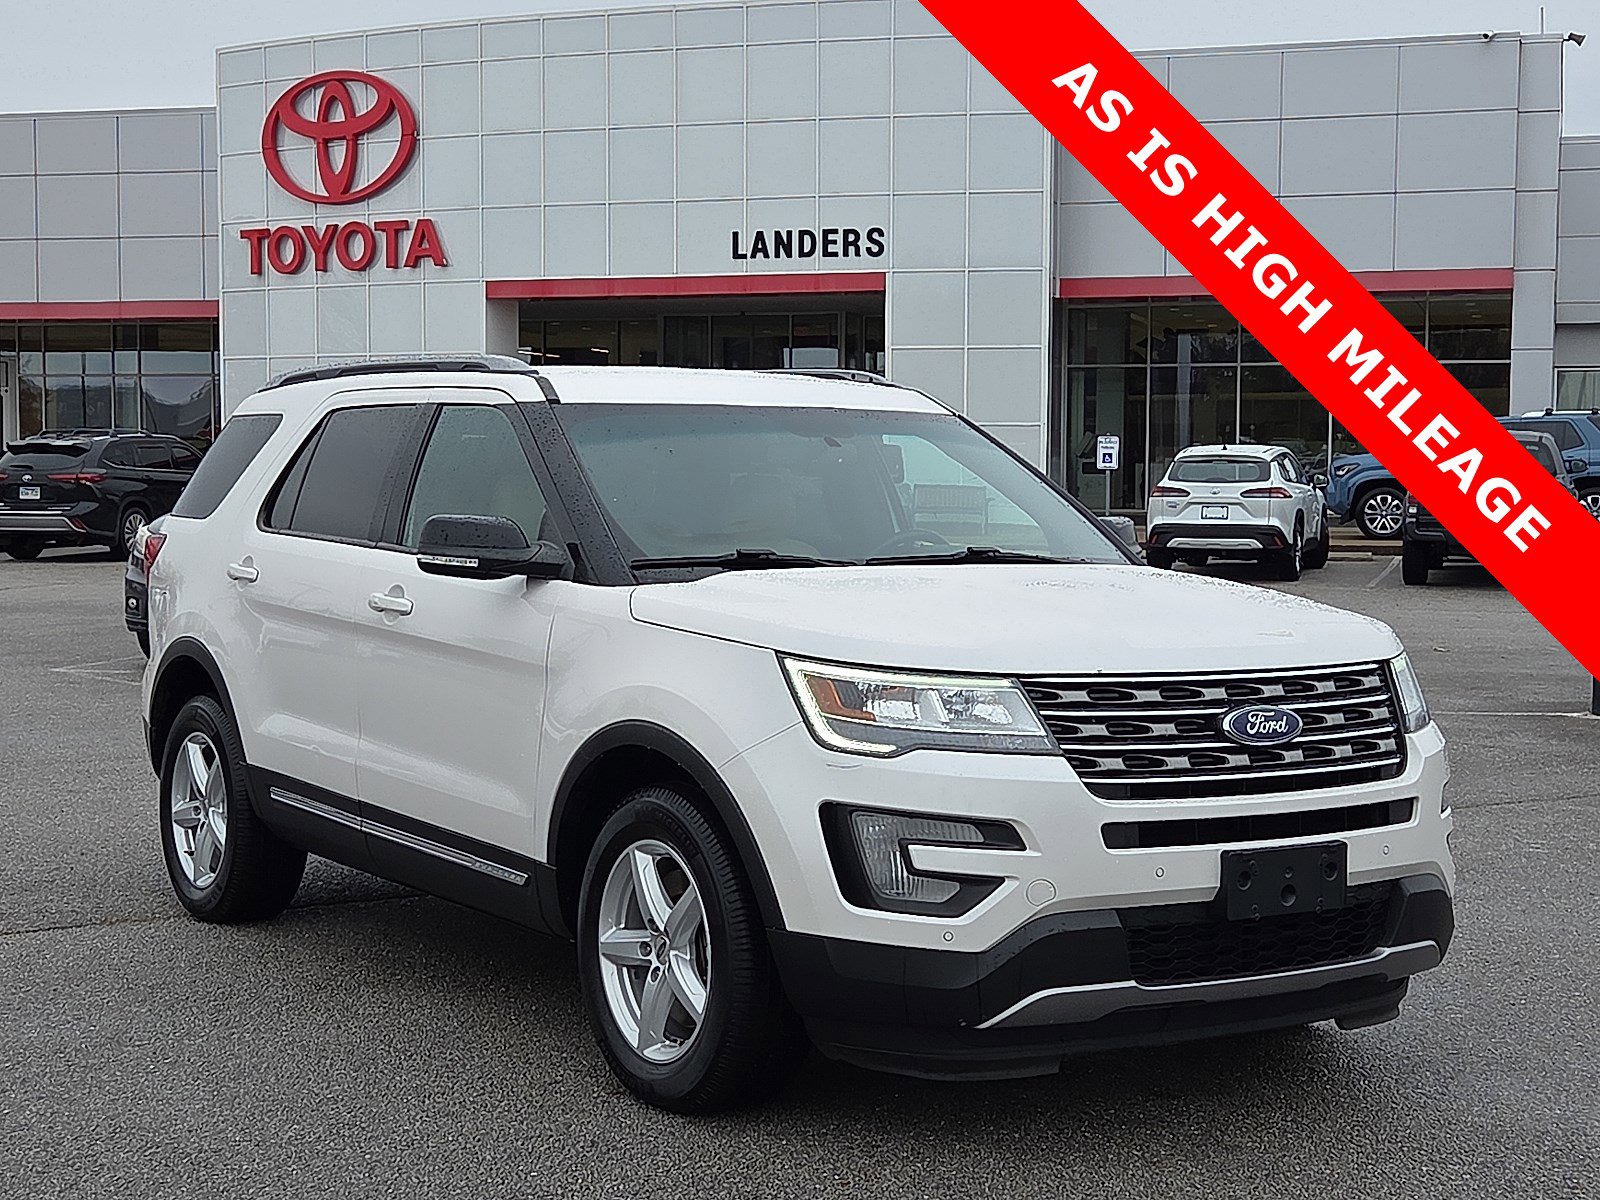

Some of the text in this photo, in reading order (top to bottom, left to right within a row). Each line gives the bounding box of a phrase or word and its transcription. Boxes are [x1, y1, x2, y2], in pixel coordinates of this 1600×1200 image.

[240, 218, 448, 275] TOYOTA
[732, 228, 885, 259] LANDERS
[1247, 711, 1288, 734] Ford
